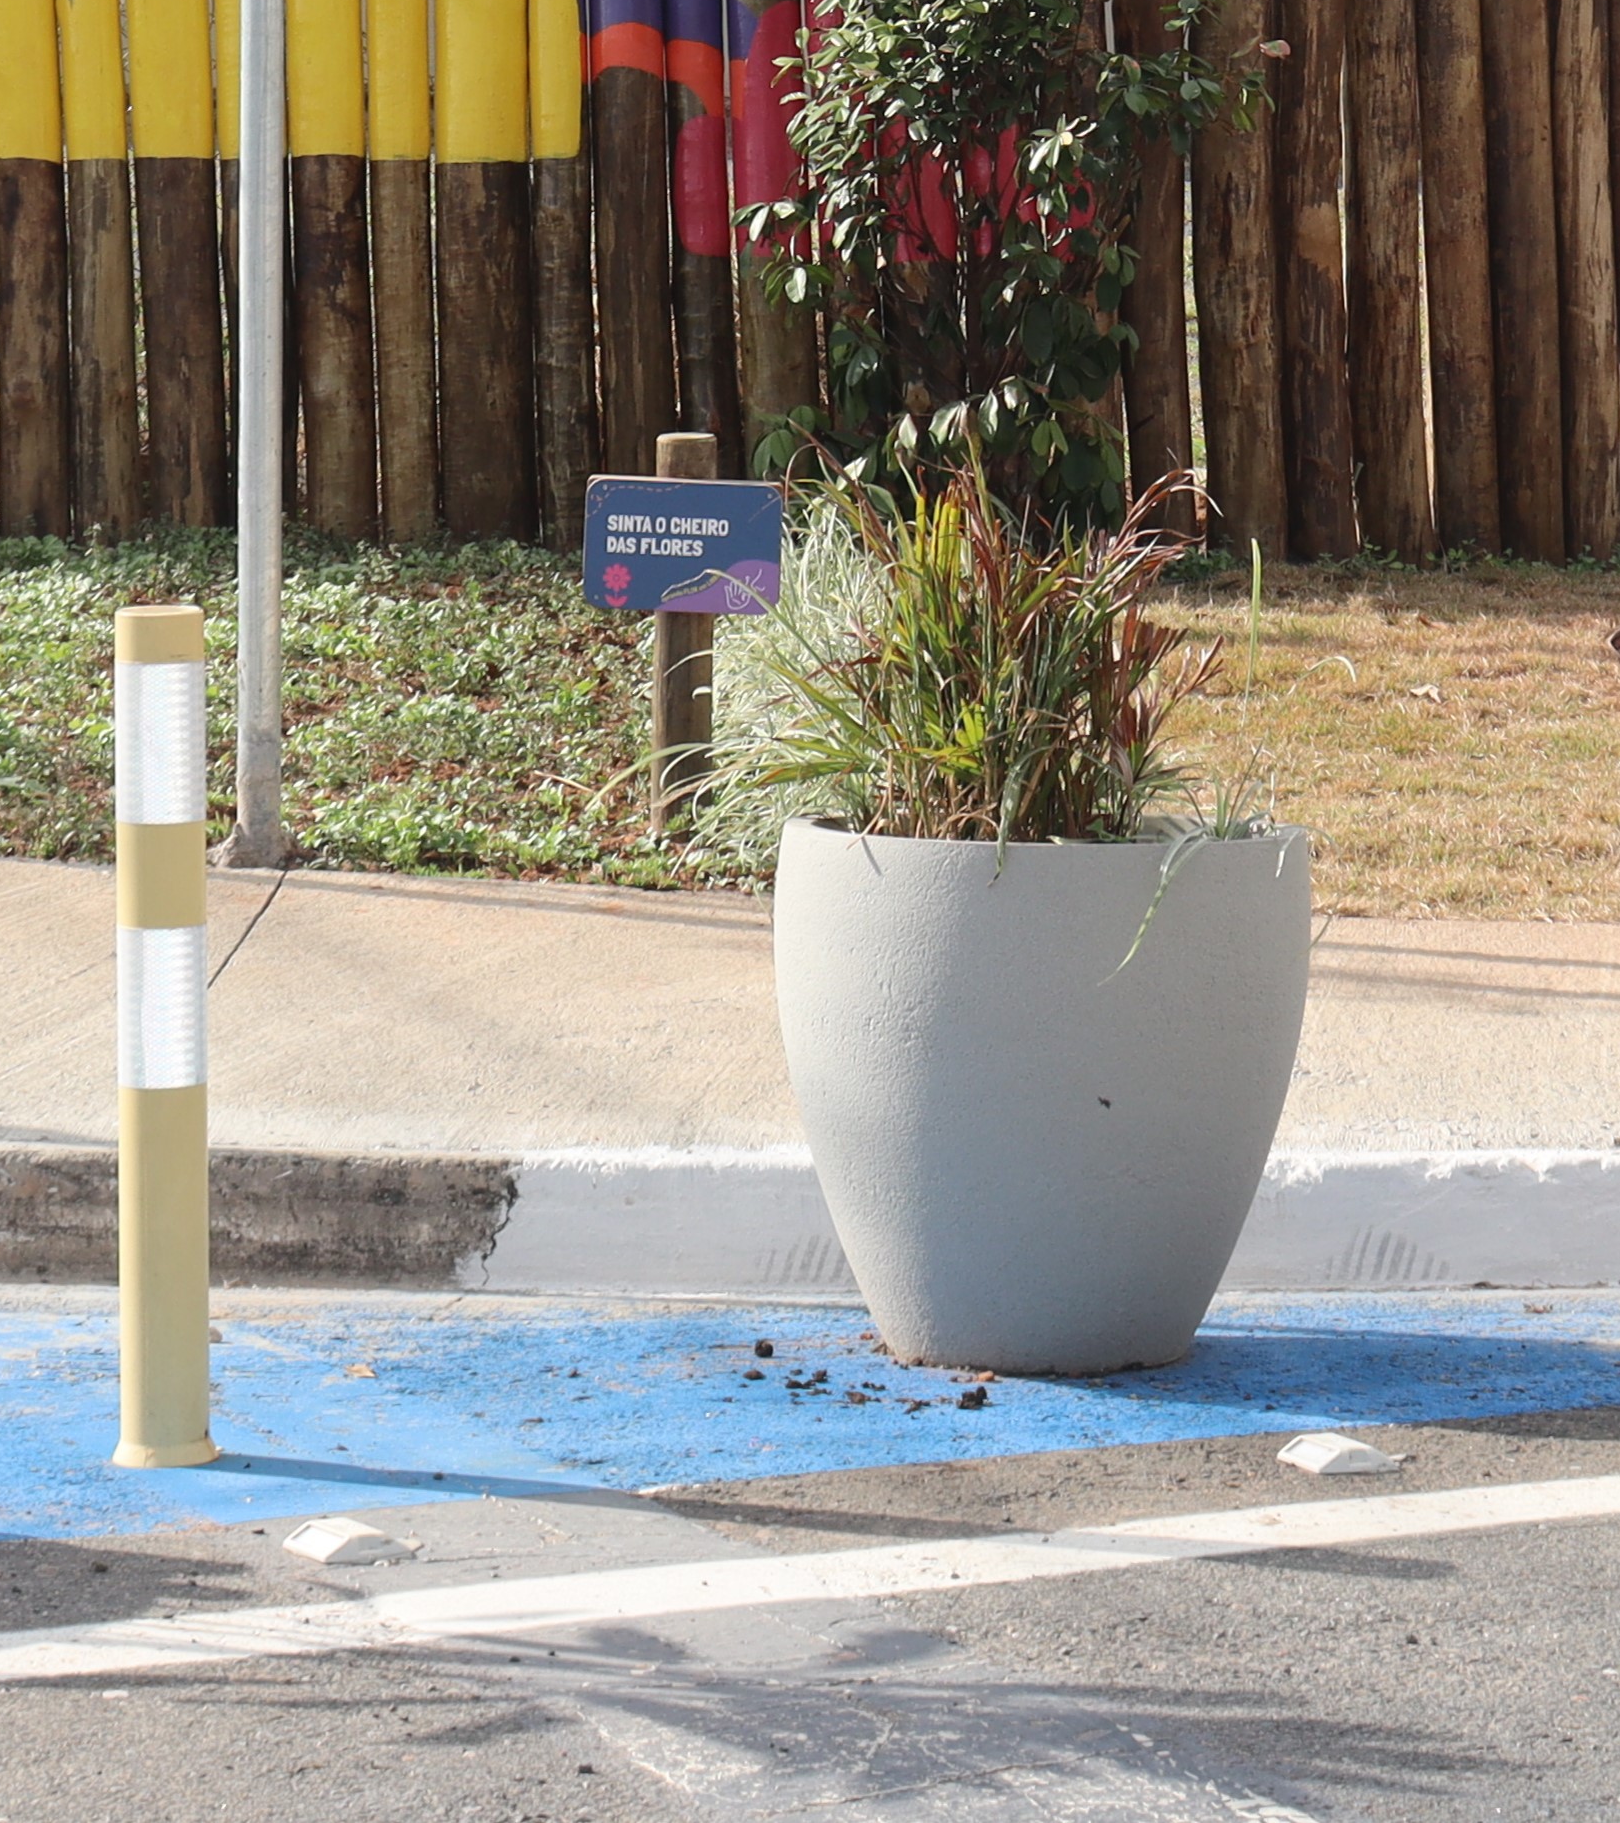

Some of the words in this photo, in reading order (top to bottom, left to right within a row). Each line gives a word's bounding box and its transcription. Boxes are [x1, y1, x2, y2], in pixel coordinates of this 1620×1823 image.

[607, 514, 652, 533] SINTA
[655, 516, 667, 535] O
[670, 517, 729, 537] CHEIRO
[606, 535, 637, 554] DAS
[640, 537, 704, 557] FLORES
